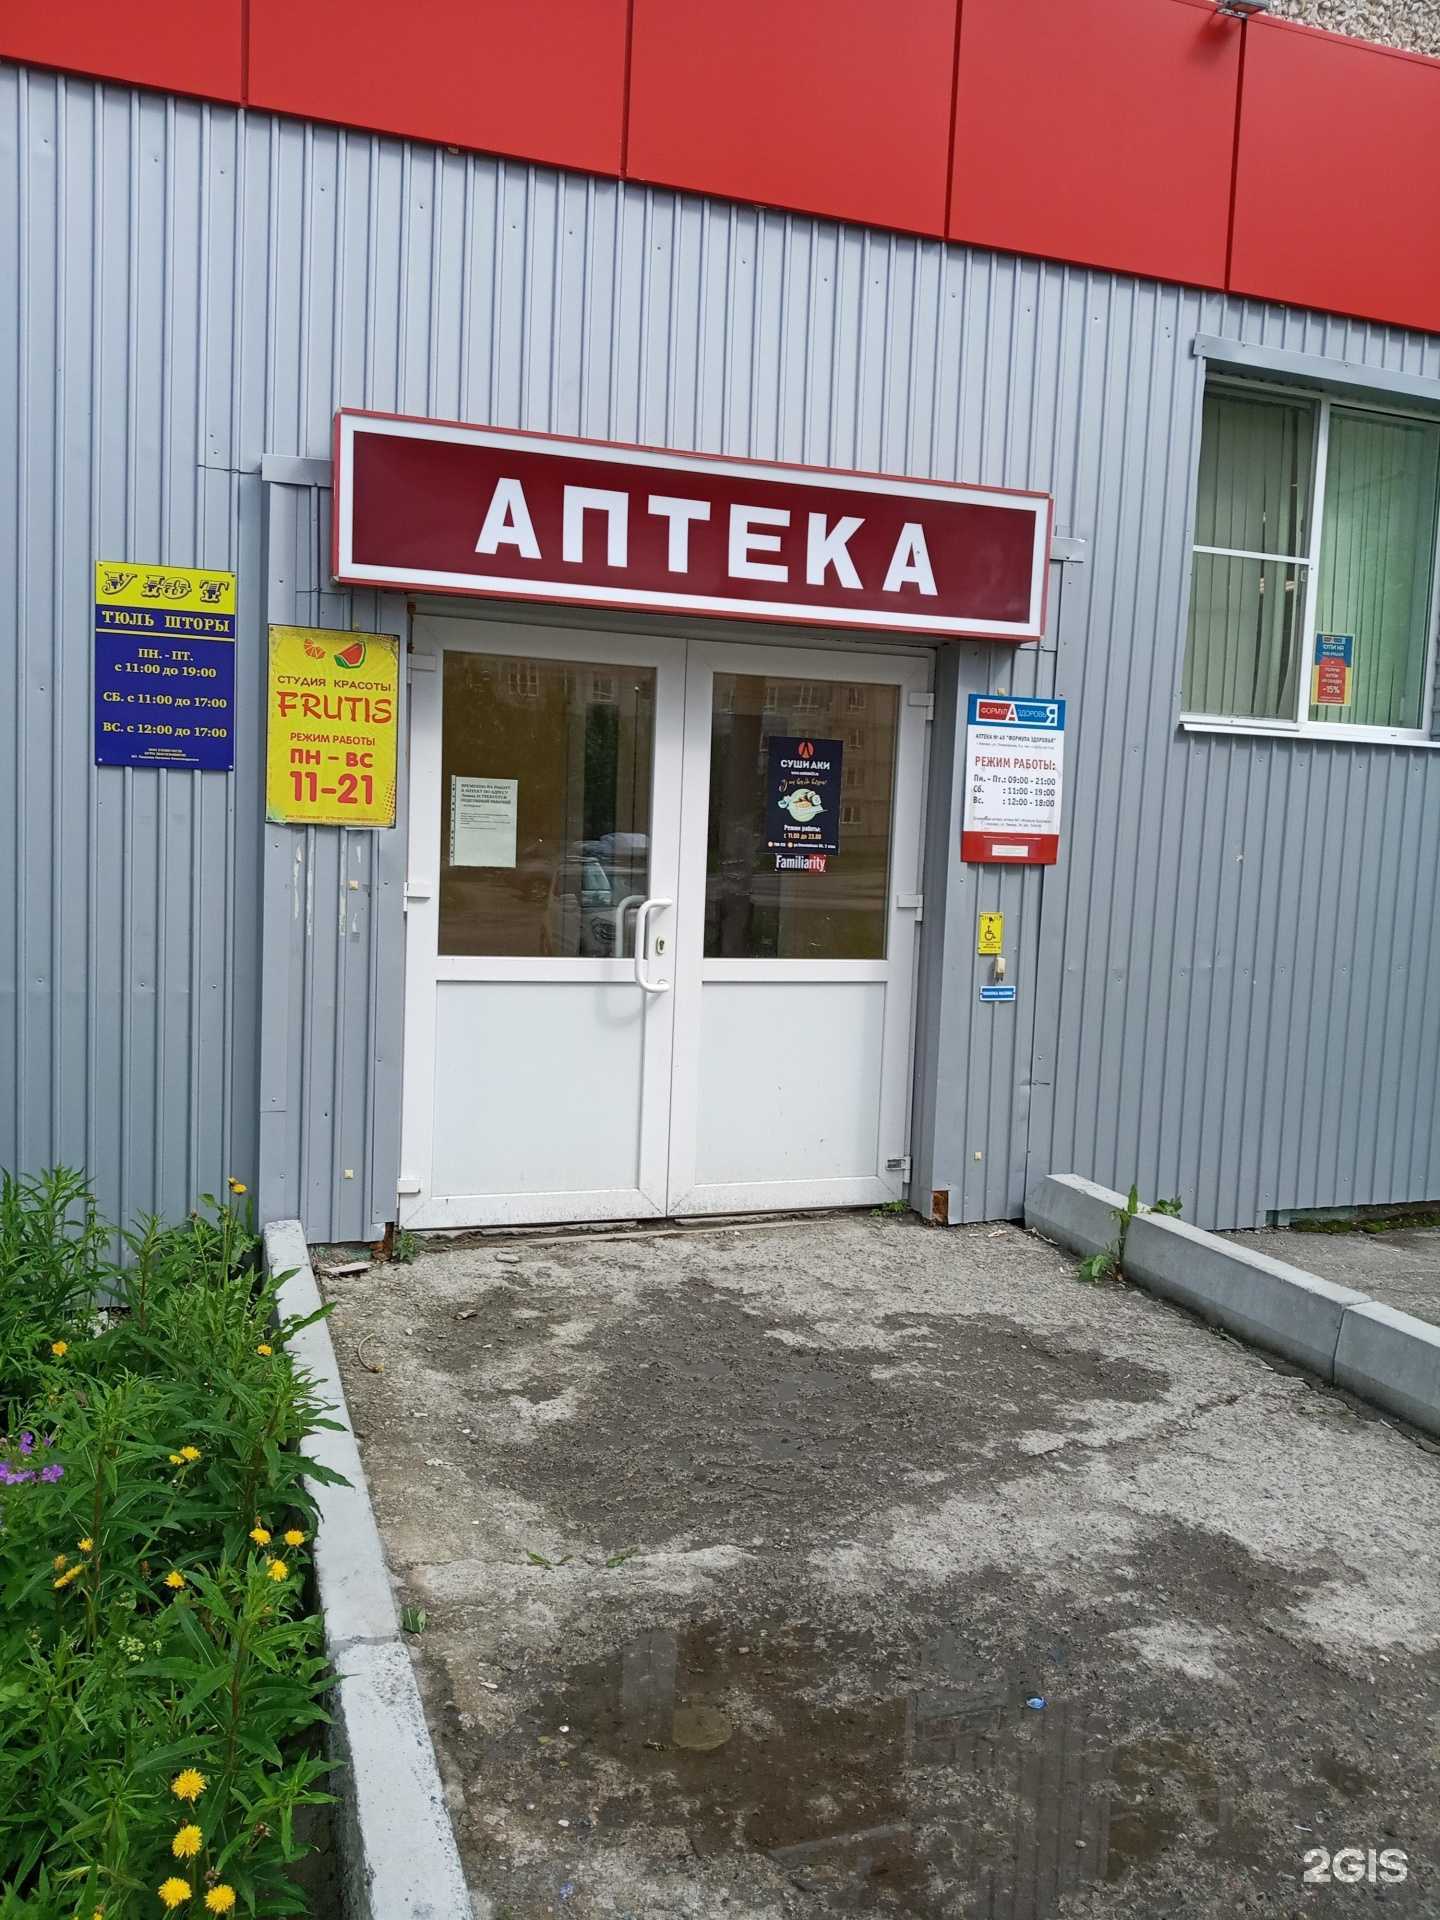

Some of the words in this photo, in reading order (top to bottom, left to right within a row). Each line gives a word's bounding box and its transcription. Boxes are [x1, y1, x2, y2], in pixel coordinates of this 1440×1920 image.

[474, 476, 939, 597] АПТЕКА
[101, 610, 155, 627] ТЮЛЬ
[164, 615, 230, 633] ШТОРЫ
[126, 663, 160, 674] 11:00
[162, 666, 179, 677] до
[182, 667, 217, 678] 19:00
[277, 675, 326, 687] СТУДИЯ
[334, 679, 391, 692] КРАСОТЫ
[103, 692, 124, 702] СБ.
[138, 694, 173, 705] 11:00
[174, 697, 191, 708] до
[194, 697, 227, 709] 17:00
[276, 690, 392, 724] FRUTIS
[103, 722, 124, 733] ВС.
[137, 724, 173, 735] 12:00
[174, 727, 191, 738] до
[194, 727, 227, 738] 17:00
[290, 732, 330, 743] РЕЖИМ
[332, 735, 375, 746] РАБОТЫ
[290, 748, 321, 766] ПН
[345, 752, 374, 769] ВС
[780, 759, 810, 769] СУШИ
[810, 760, 830, 770] АКИ
[975, 755, 1011, 768] РЕЖИМ
[1013, 757, 1057, 771] РАБОТЫ:
[289, 770, 374, 805] 11-21
[1008, 776, 1029, 785] 09:00
[1035, 777, 1056, 786] 21:00
[1035, 788, 1056, 797] 19:00
[776, 854, 826, 872] Familiarity
